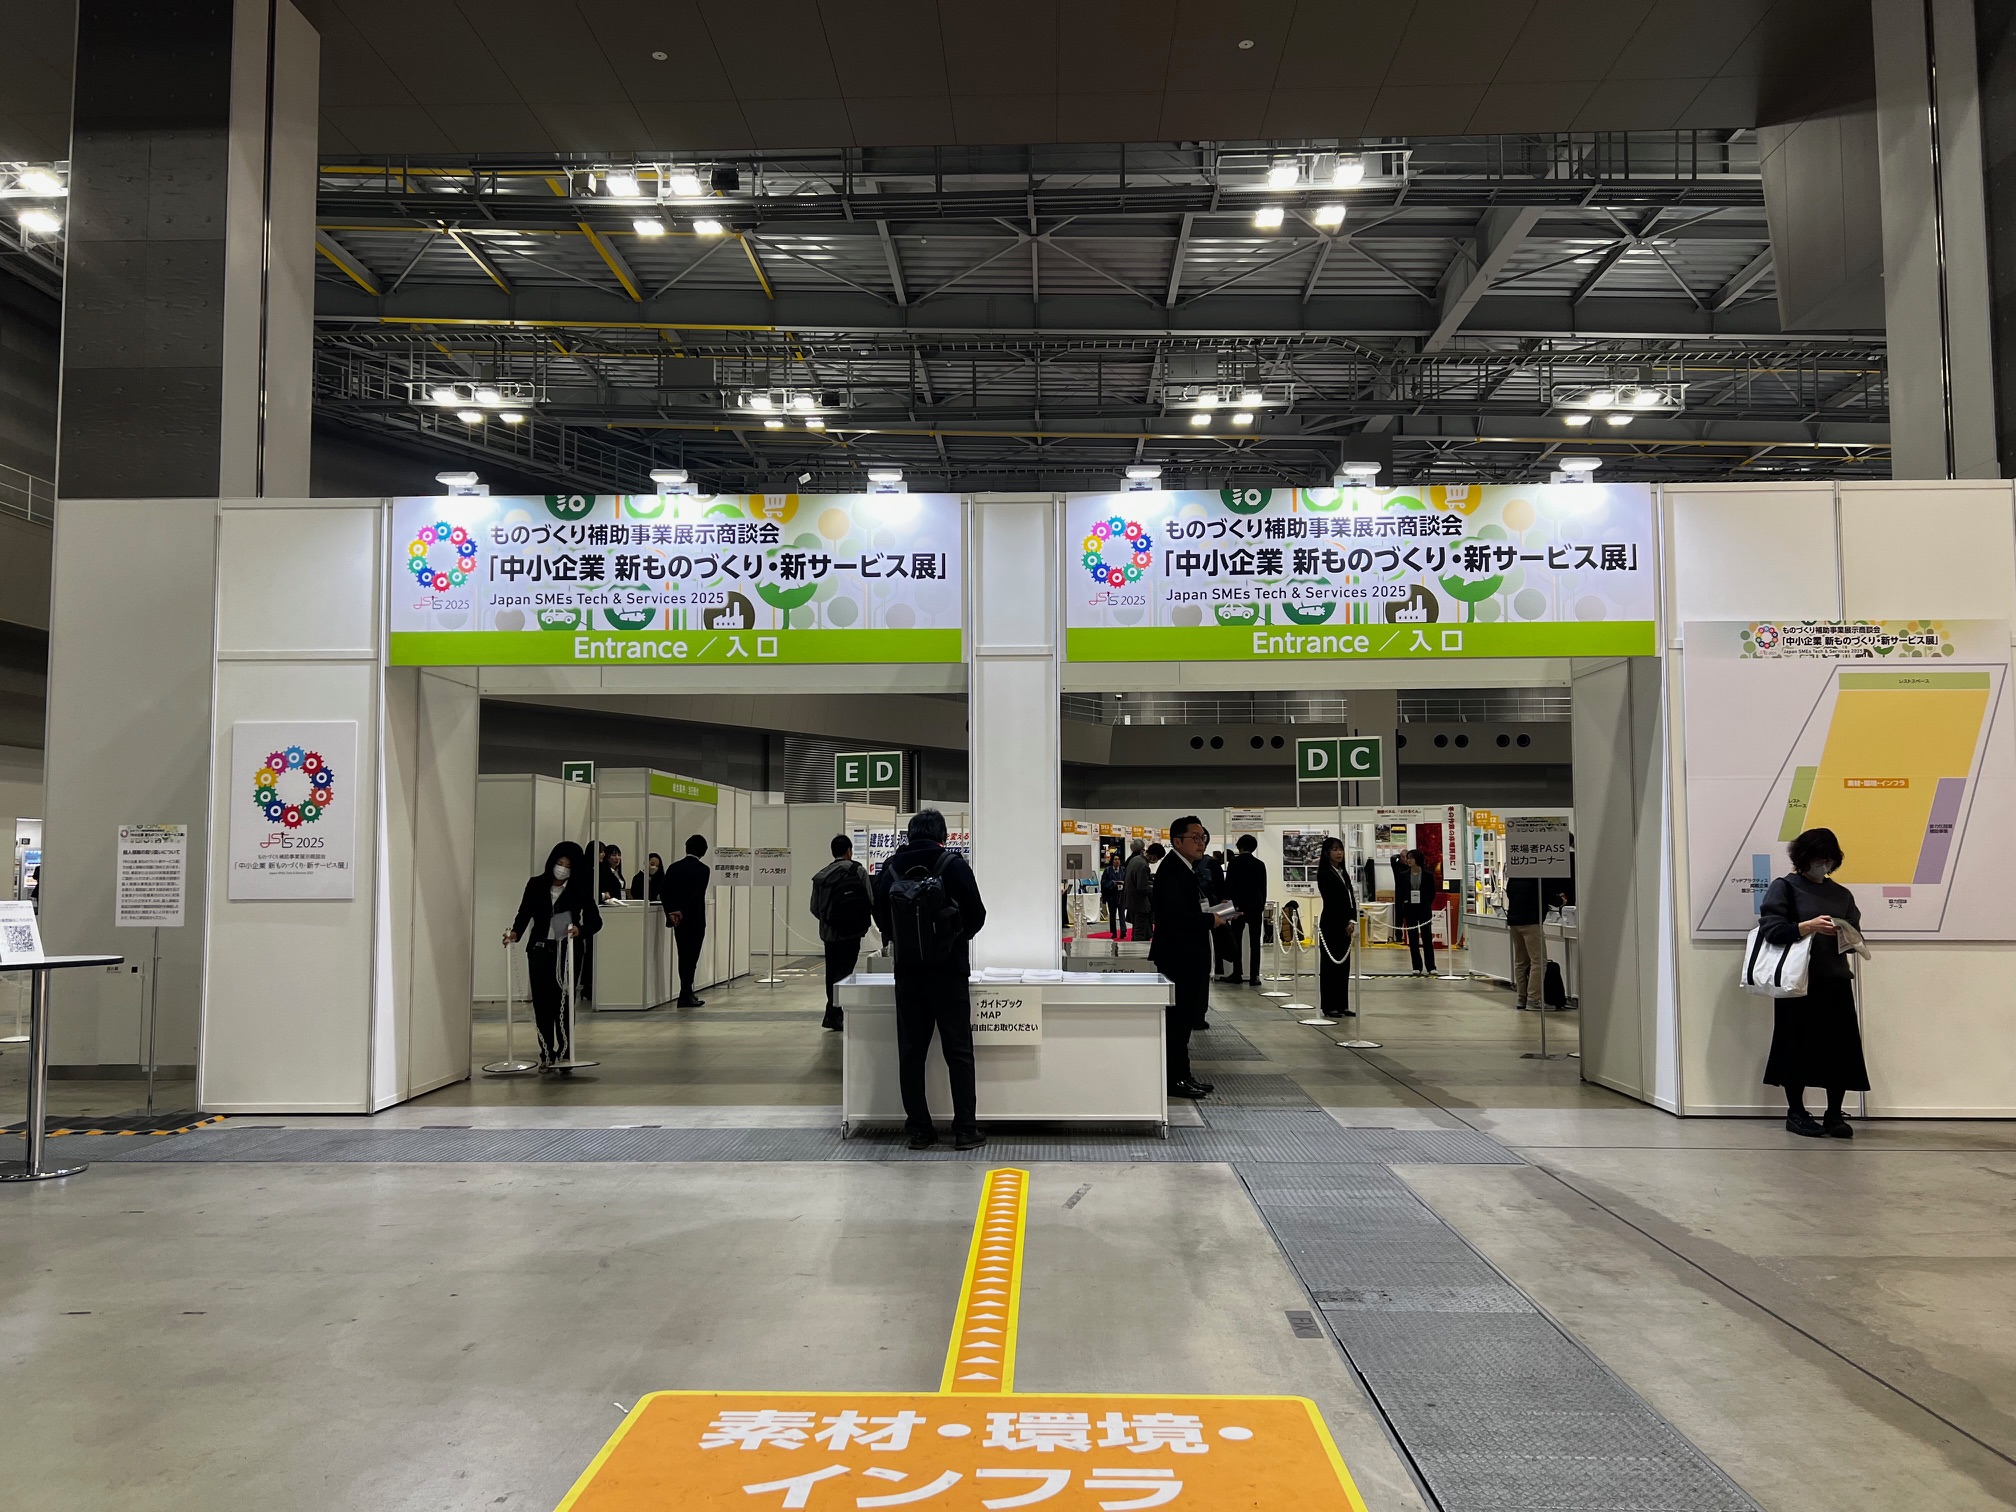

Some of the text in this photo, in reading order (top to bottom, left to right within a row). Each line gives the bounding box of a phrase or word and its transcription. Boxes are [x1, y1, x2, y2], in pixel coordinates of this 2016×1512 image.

[490, 523, 780, 545] ものづくり補助事業展示商談会
[1166, 515, 1463, 538] ものづくり補助事業展示商談会
[488, 551, 947, 582] 「中小企業 新ものづくり・新サービス展」
[1164, 543, 1640, 577] 「中小企業 新ものづくり・新サービス展」
[489, 592, 725, 608] Japan SMEs Tech & Services 2025
[1120, 596, 1146, 606] 2025
[1166, 586, 1407, 602] Japan SMEs Tech & Services 2025
[444, 599, 470, 610] 2025
[1782, 626, 1881, 635] ものづくり補助事業展示商談会
[573, 636, 688, 660] Entrance
[725, 636, 778, 659] 入口
[1253, 632, 1369, 655] Entrance
[1408, 631, 1463, 653] 入口
[1781, 636, 1939, 647] 「中小企業 新ものづくり・新サービス展」
[1307, 747, 1371, 771] D C
[846, 761, 893, 783] E D
[296, 837, 324, 848] 2025
[1510, 844, 1565, 853] 来場者PASS
[234, 861, 266, 870] 「中小企業
[1510, 856, 1565, 866] 出力コーナー
[742, 1463, 1184, 1511] インフラ
